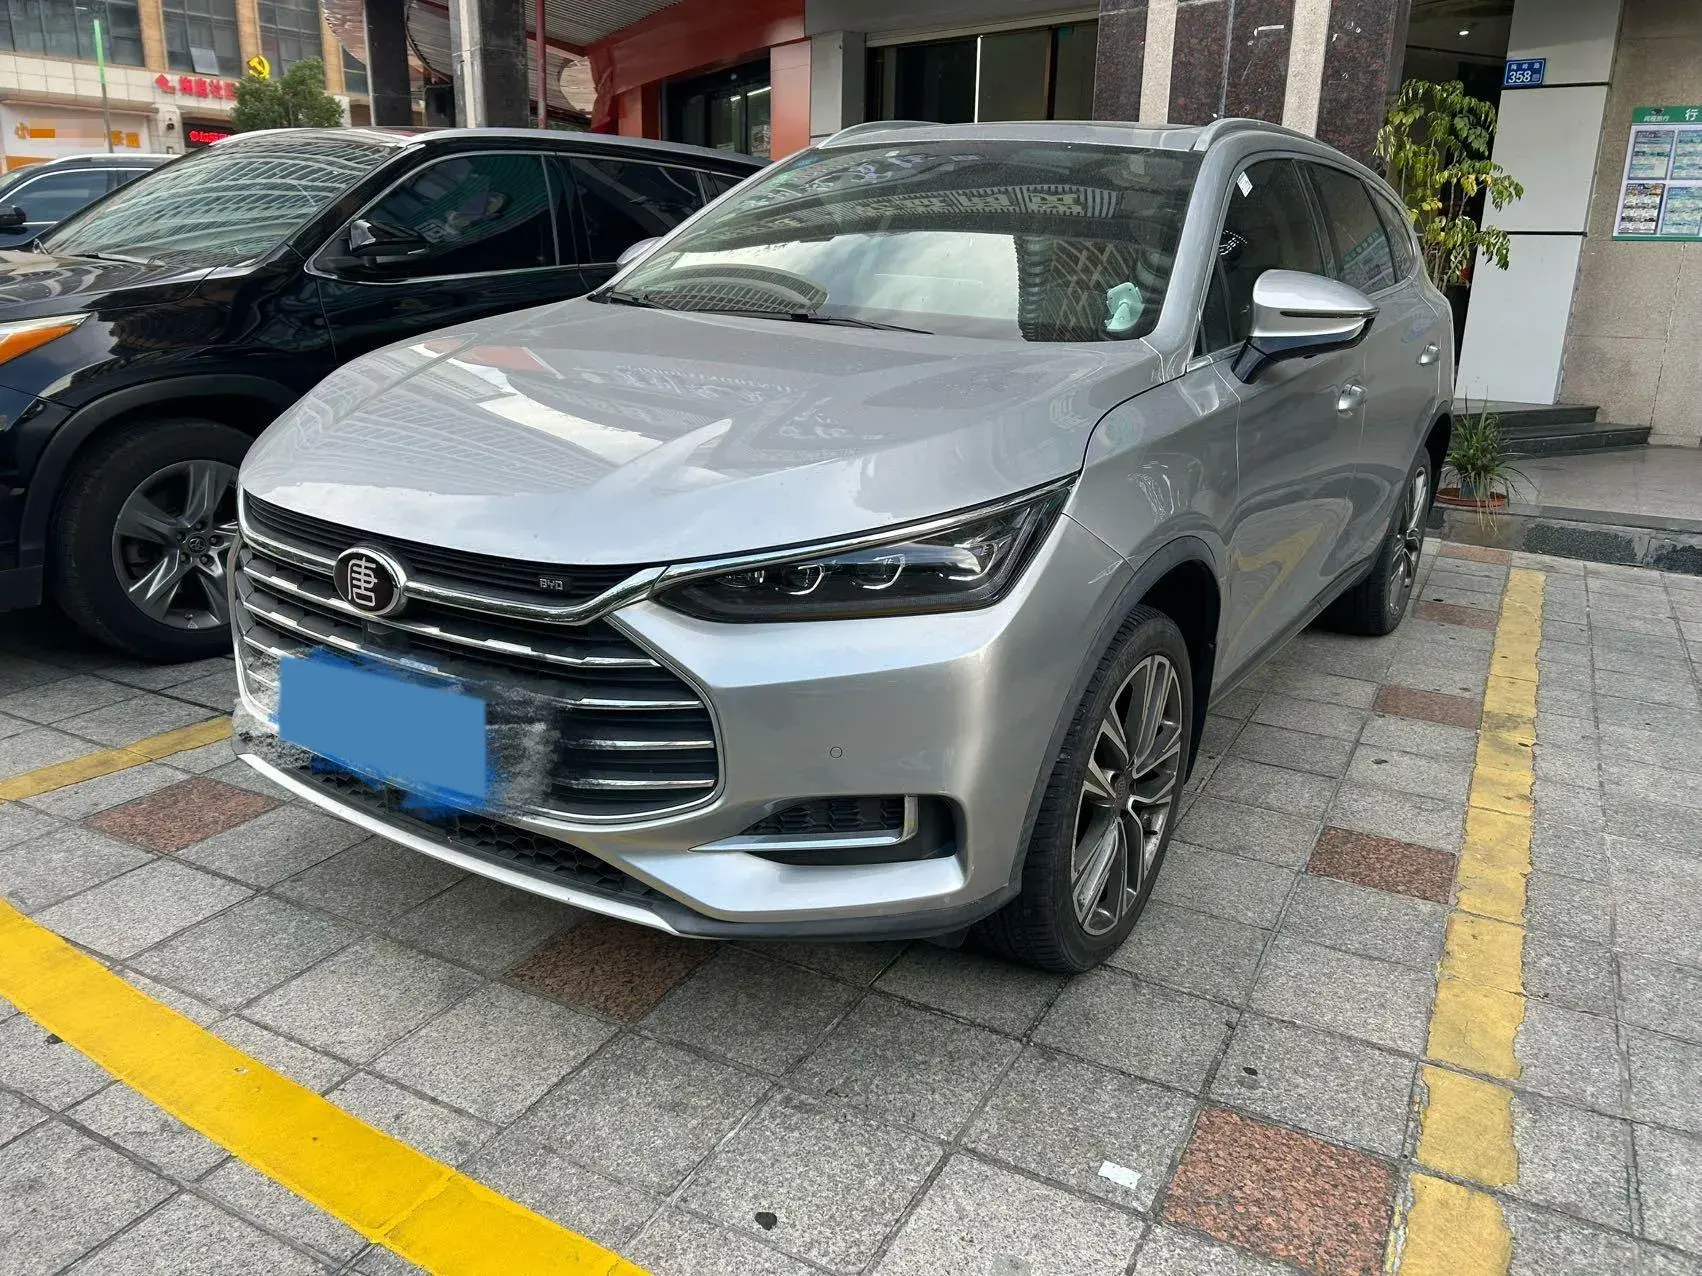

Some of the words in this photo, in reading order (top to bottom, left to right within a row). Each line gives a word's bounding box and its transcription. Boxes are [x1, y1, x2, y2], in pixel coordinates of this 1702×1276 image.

[1508, 70, 1532, 83] 358
[347, 556, 378, 607] 唐
[539, 578, 564, 591] BYD
